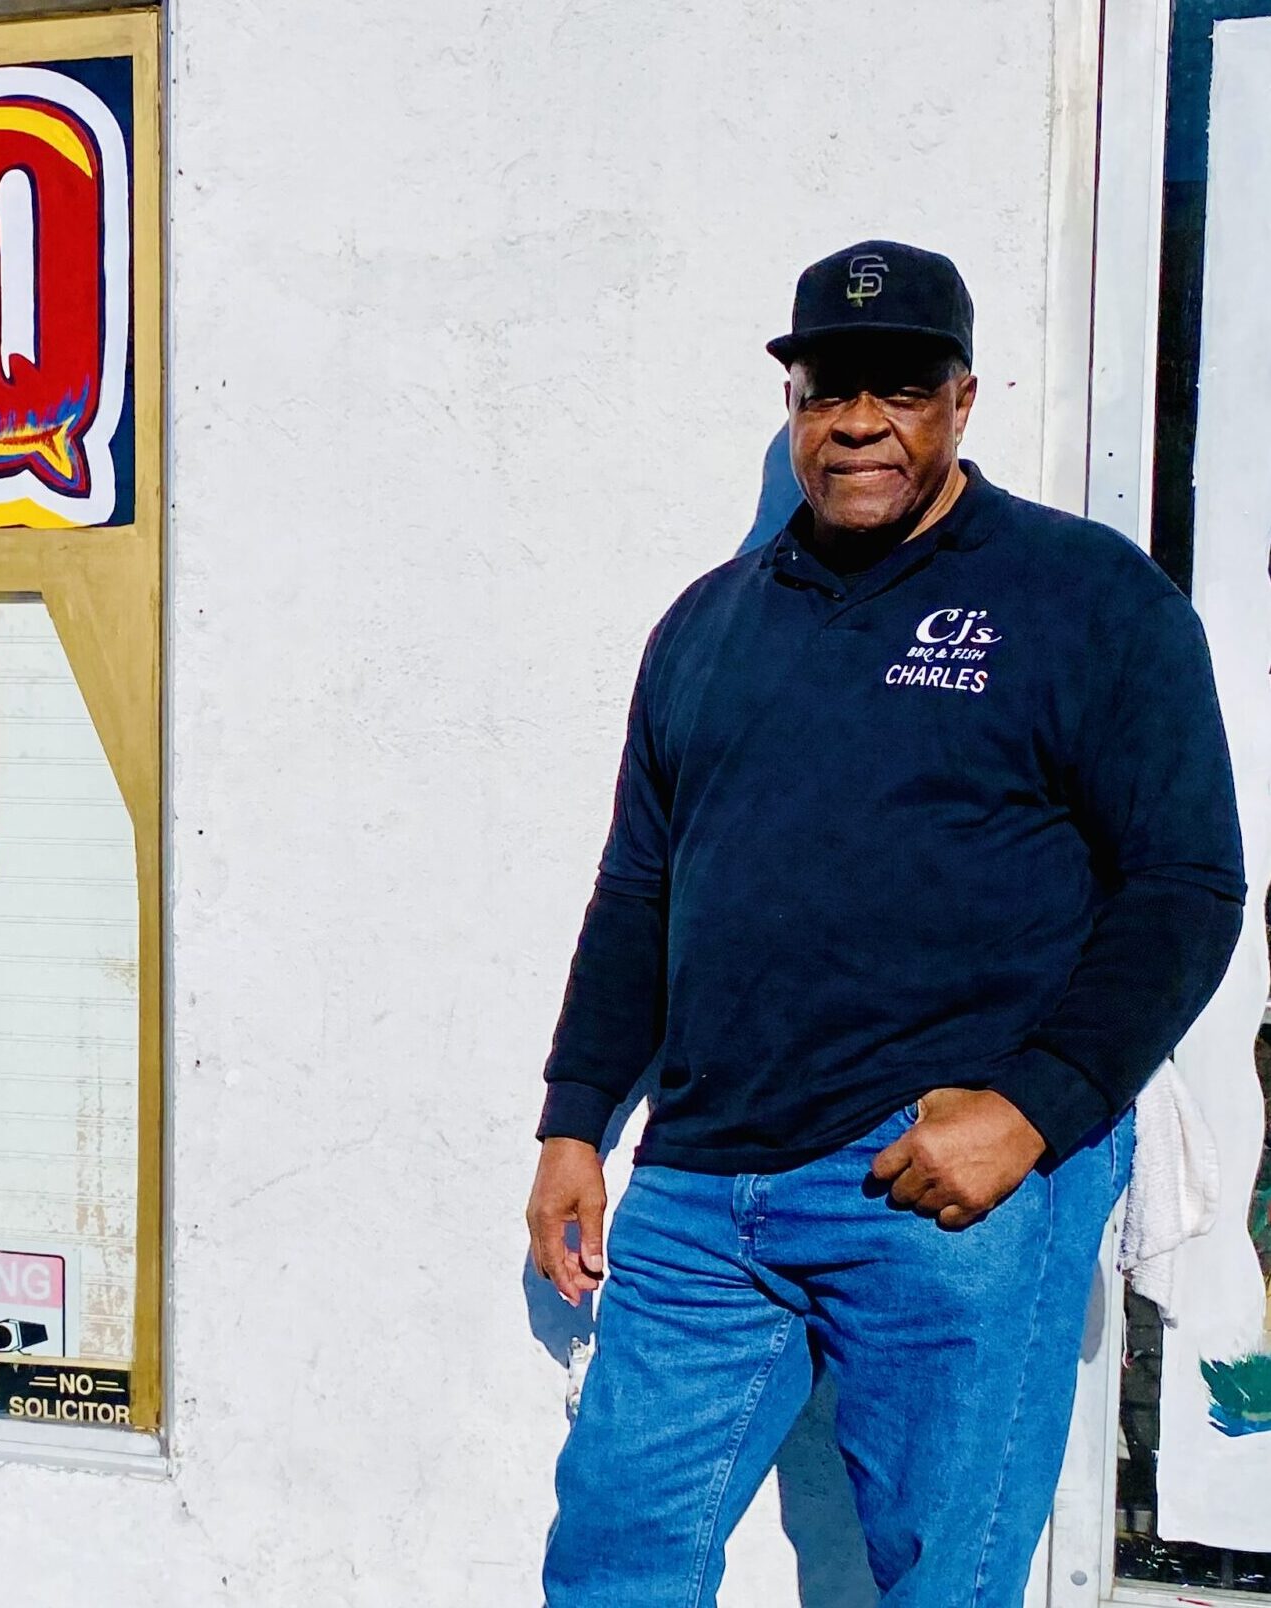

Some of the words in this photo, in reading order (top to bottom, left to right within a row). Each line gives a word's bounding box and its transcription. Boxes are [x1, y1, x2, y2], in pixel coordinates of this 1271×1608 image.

[906, 646, 934, 663] BBQ
[935, 648, 947, 659] &
[950, 648, 986, 660] FISH
[885, 664, 988, 693] CHARLES
[59, 1373, 94, 1395] NO
[9, 1396, 130, 1424] SOLICITOR
